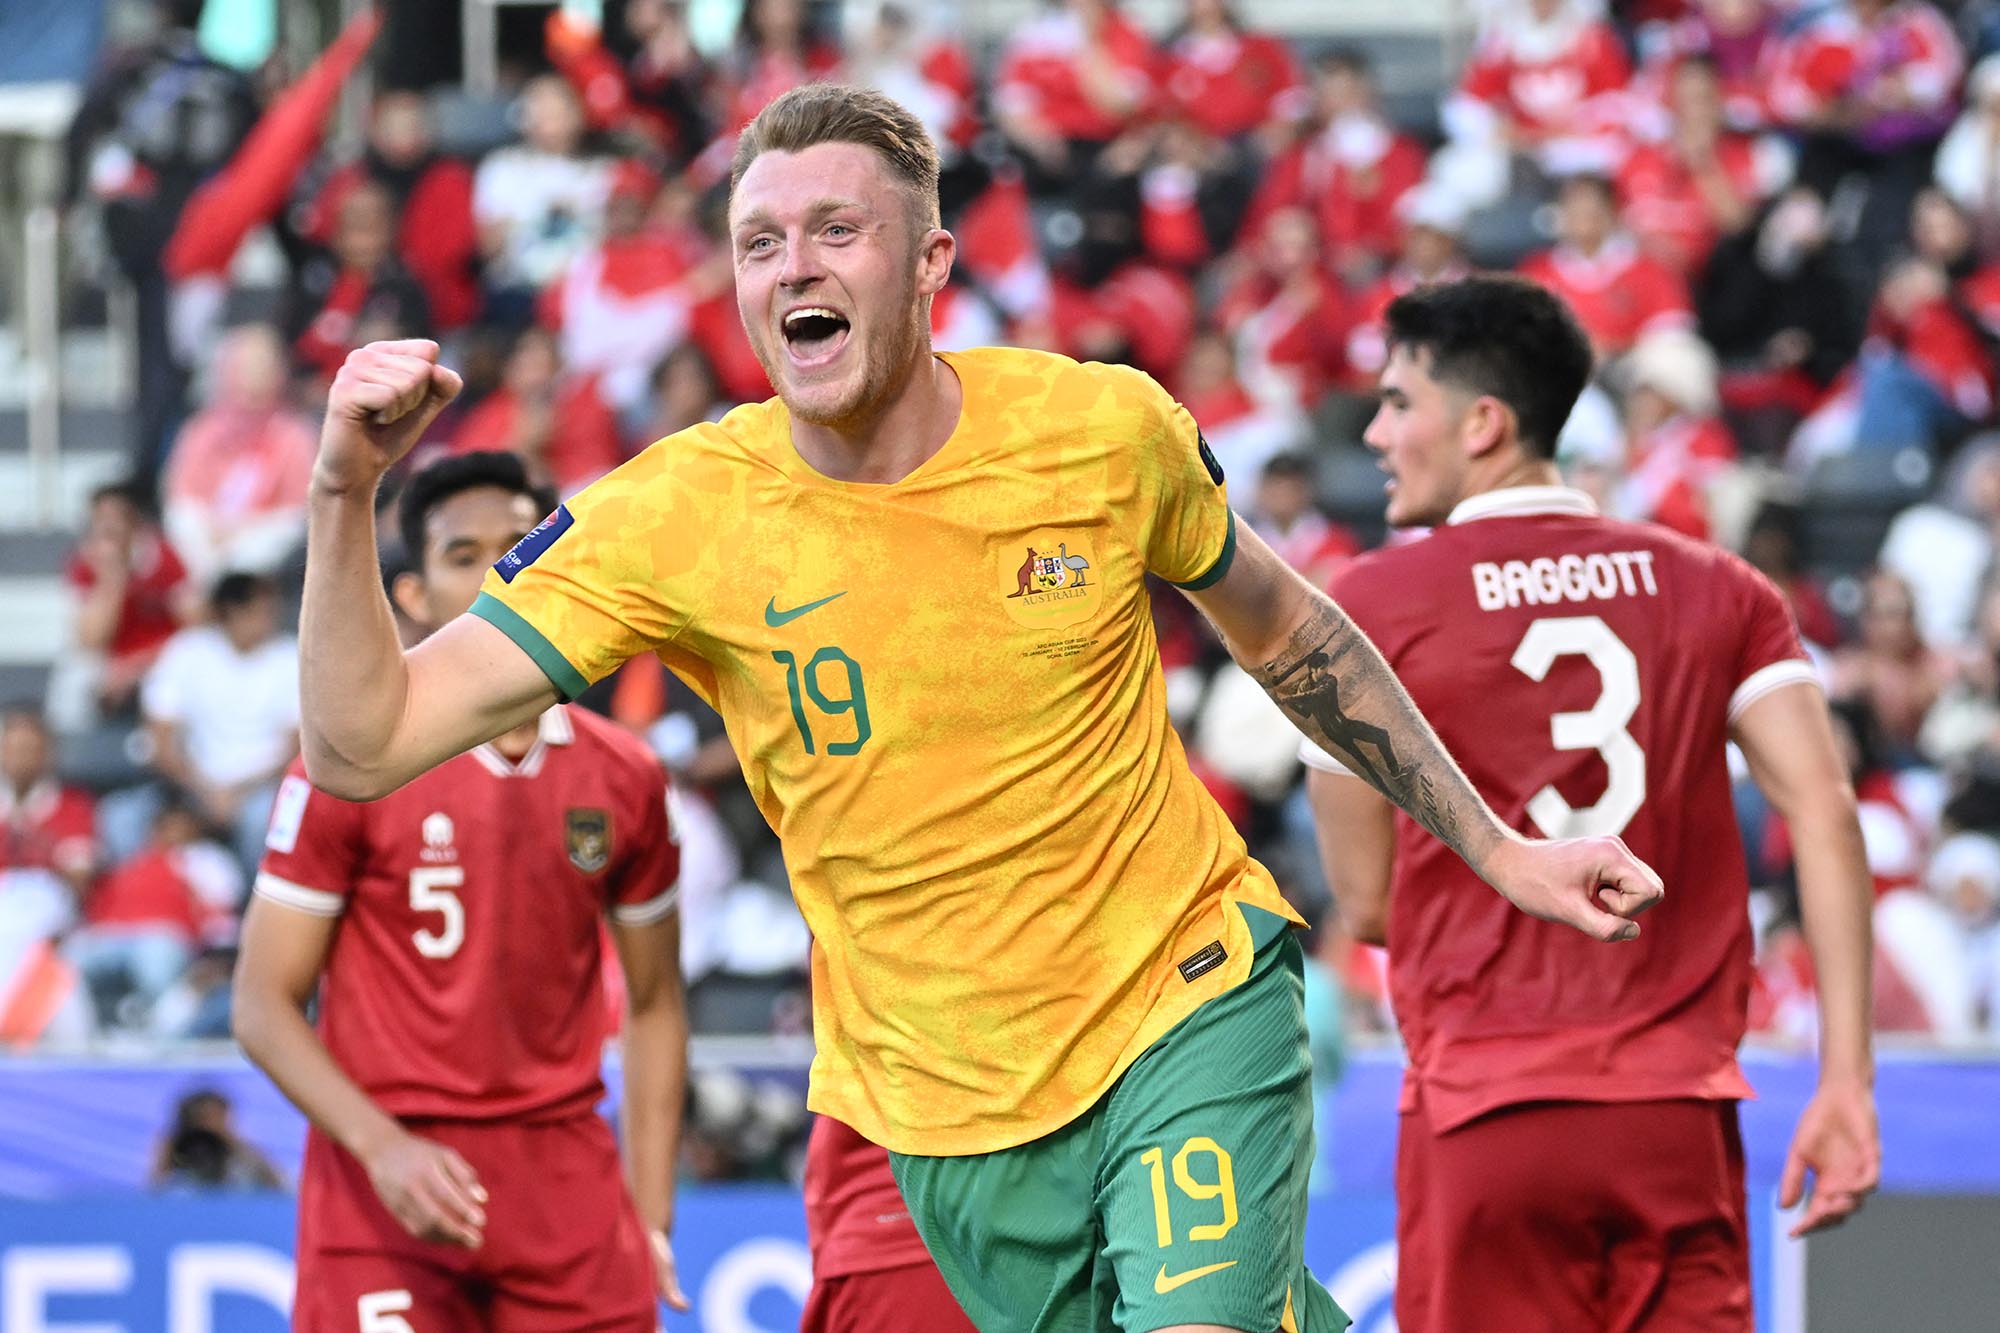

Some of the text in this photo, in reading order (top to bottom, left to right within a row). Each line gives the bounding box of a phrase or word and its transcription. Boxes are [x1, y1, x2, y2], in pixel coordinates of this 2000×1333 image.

[508, 552, 522, 565] CUP
[1023, 588, 1087, 606] AUSTRALIA
[1471, 550, 1658, 612] BAGGOTT
[771, 646, 872, 756] 19
[1510, 615, 1647, 841] 3
[409, 865, 465, 959] 5
[1140, 1136, 1239, 1248] 19
